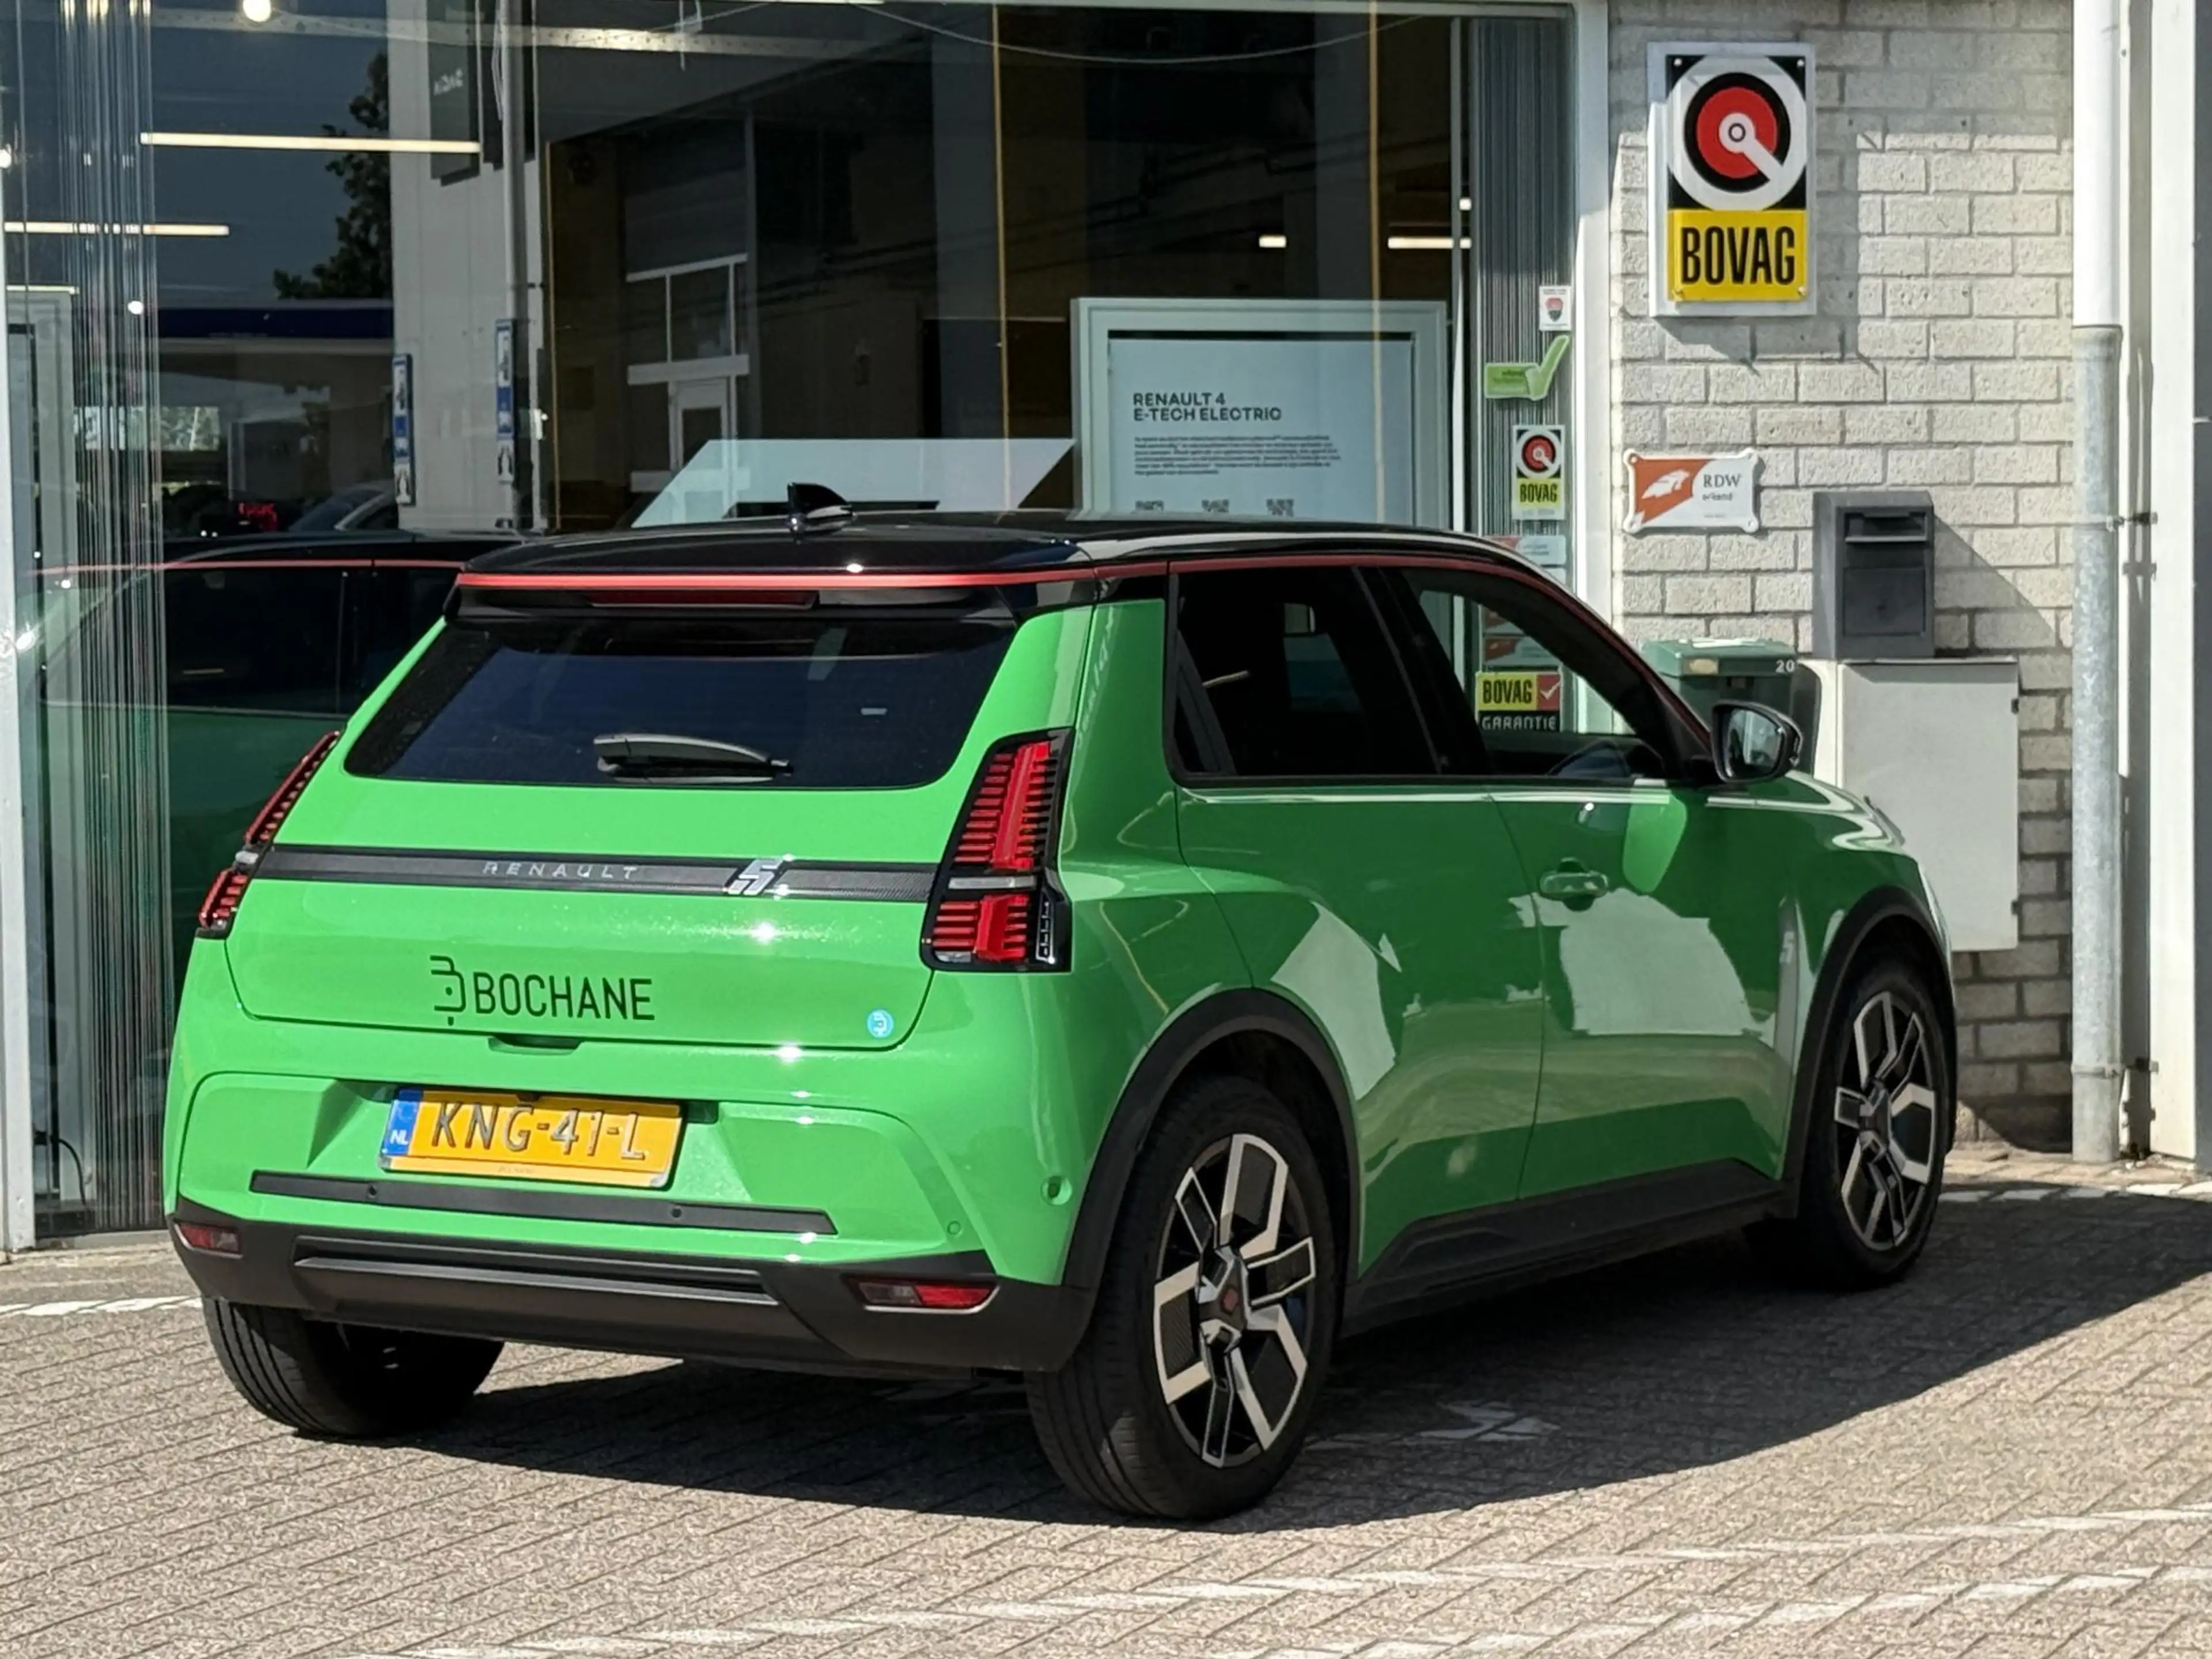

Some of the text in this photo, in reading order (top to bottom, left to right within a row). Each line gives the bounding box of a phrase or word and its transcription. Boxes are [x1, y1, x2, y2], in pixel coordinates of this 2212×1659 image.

[1681, 226, 1795, 286] BOVAG
[1132, 392, 1226, 406] RENAULT 4
[1133, 407, 1282, 422] E-TECH ELECTRIC
[1703, 474, 1742, 488] RDW
[1520, 483, 1558, 503] BOVAG
[1775, 659, 1796, 673] 20
[1482, 679, 1533, 704] BOVAG
[1481, 715, 1556, 731] GARANTIE
[482, 861, 638, 880] RENAULT
[472, 971, 656, 1021] BOCHANE
[389, 1130, 408, 1145] NL
[431, 1101, 645, 1161] KNG-41-L
